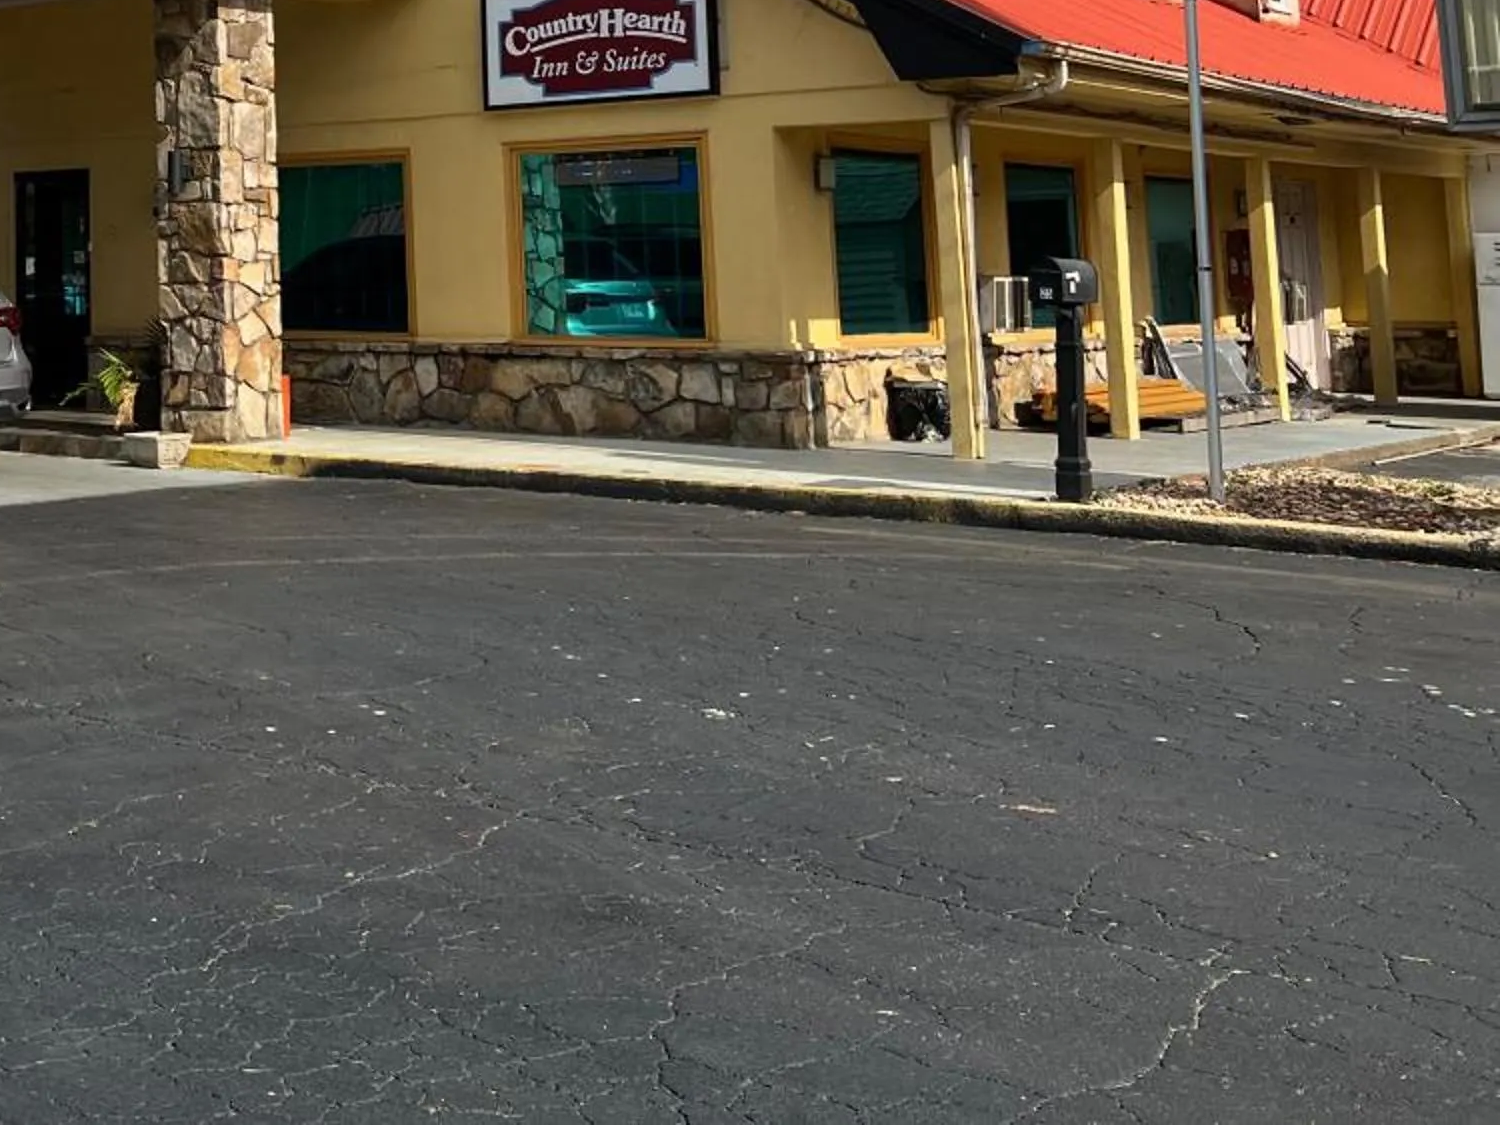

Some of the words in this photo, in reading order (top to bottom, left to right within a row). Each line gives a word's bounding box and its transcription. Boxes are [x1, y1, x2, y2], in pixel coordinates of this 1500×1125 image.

[505, 12, 599, 56] Country
[599, 8, 686, 38] Hearth
[532, 56, 569, 78] Inn
[575, 51, 599, 74] &
[603, 47, 667, 73] Suites
